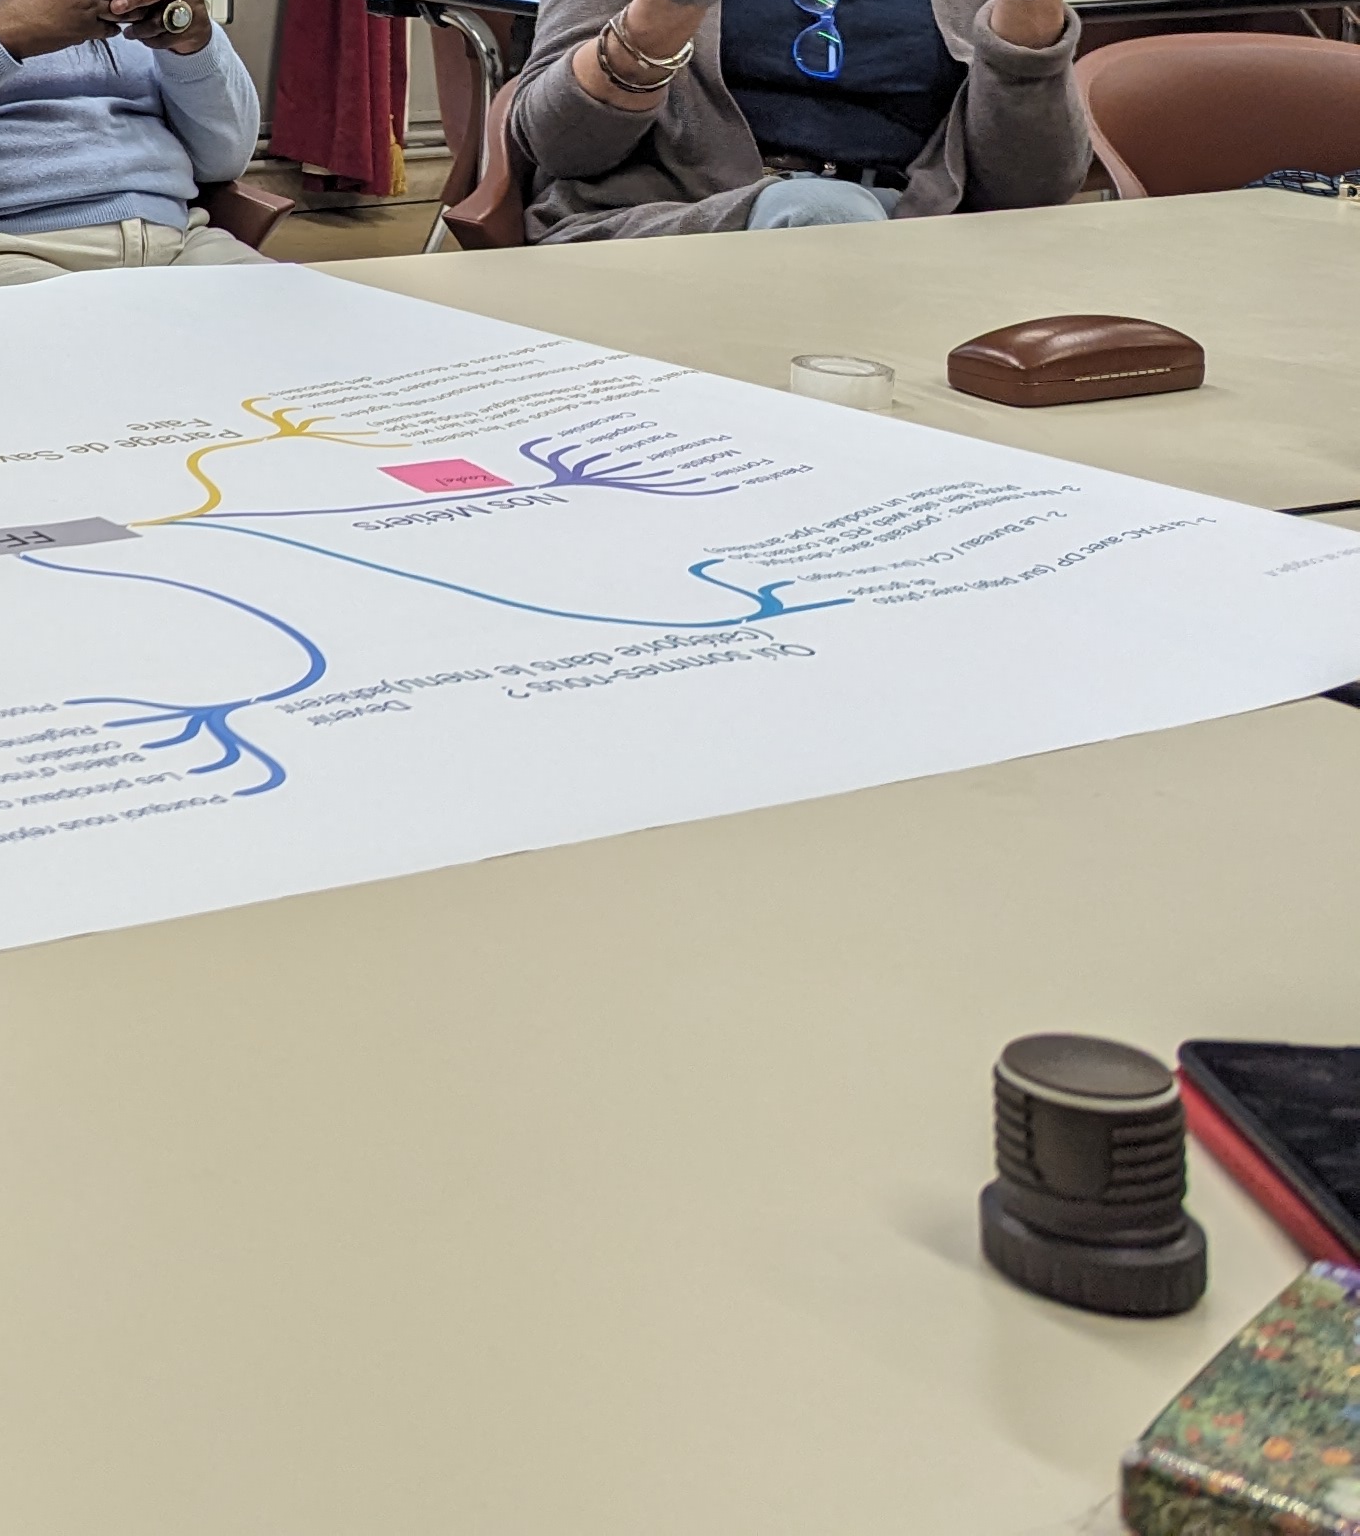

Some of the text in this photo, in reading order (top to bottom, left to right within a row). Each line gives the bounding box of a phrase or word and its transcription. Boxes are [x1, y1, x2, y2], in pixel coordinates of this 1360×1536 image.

[114, 428, 244, 448] Partage
[126, 418, 212, 432] Faire
[66, 442, 110, 454] de
[352, 492, 570, 532] Nos Métiers
[380, 626, 774, 694] (catégorie dans le menu)
[748, 642, 816, 662] Qui
[526, 650, 752, 694] sommes-nous
[306, 700, 414, 726] Devenir
[16, 740, 124, 766] cotisation
[14, 778, 136, 806] principaux
[134, 772, 184, 786] Les
[118, 794, 230, 822] Pourquoi
[58, 814, 120, 832] nous
